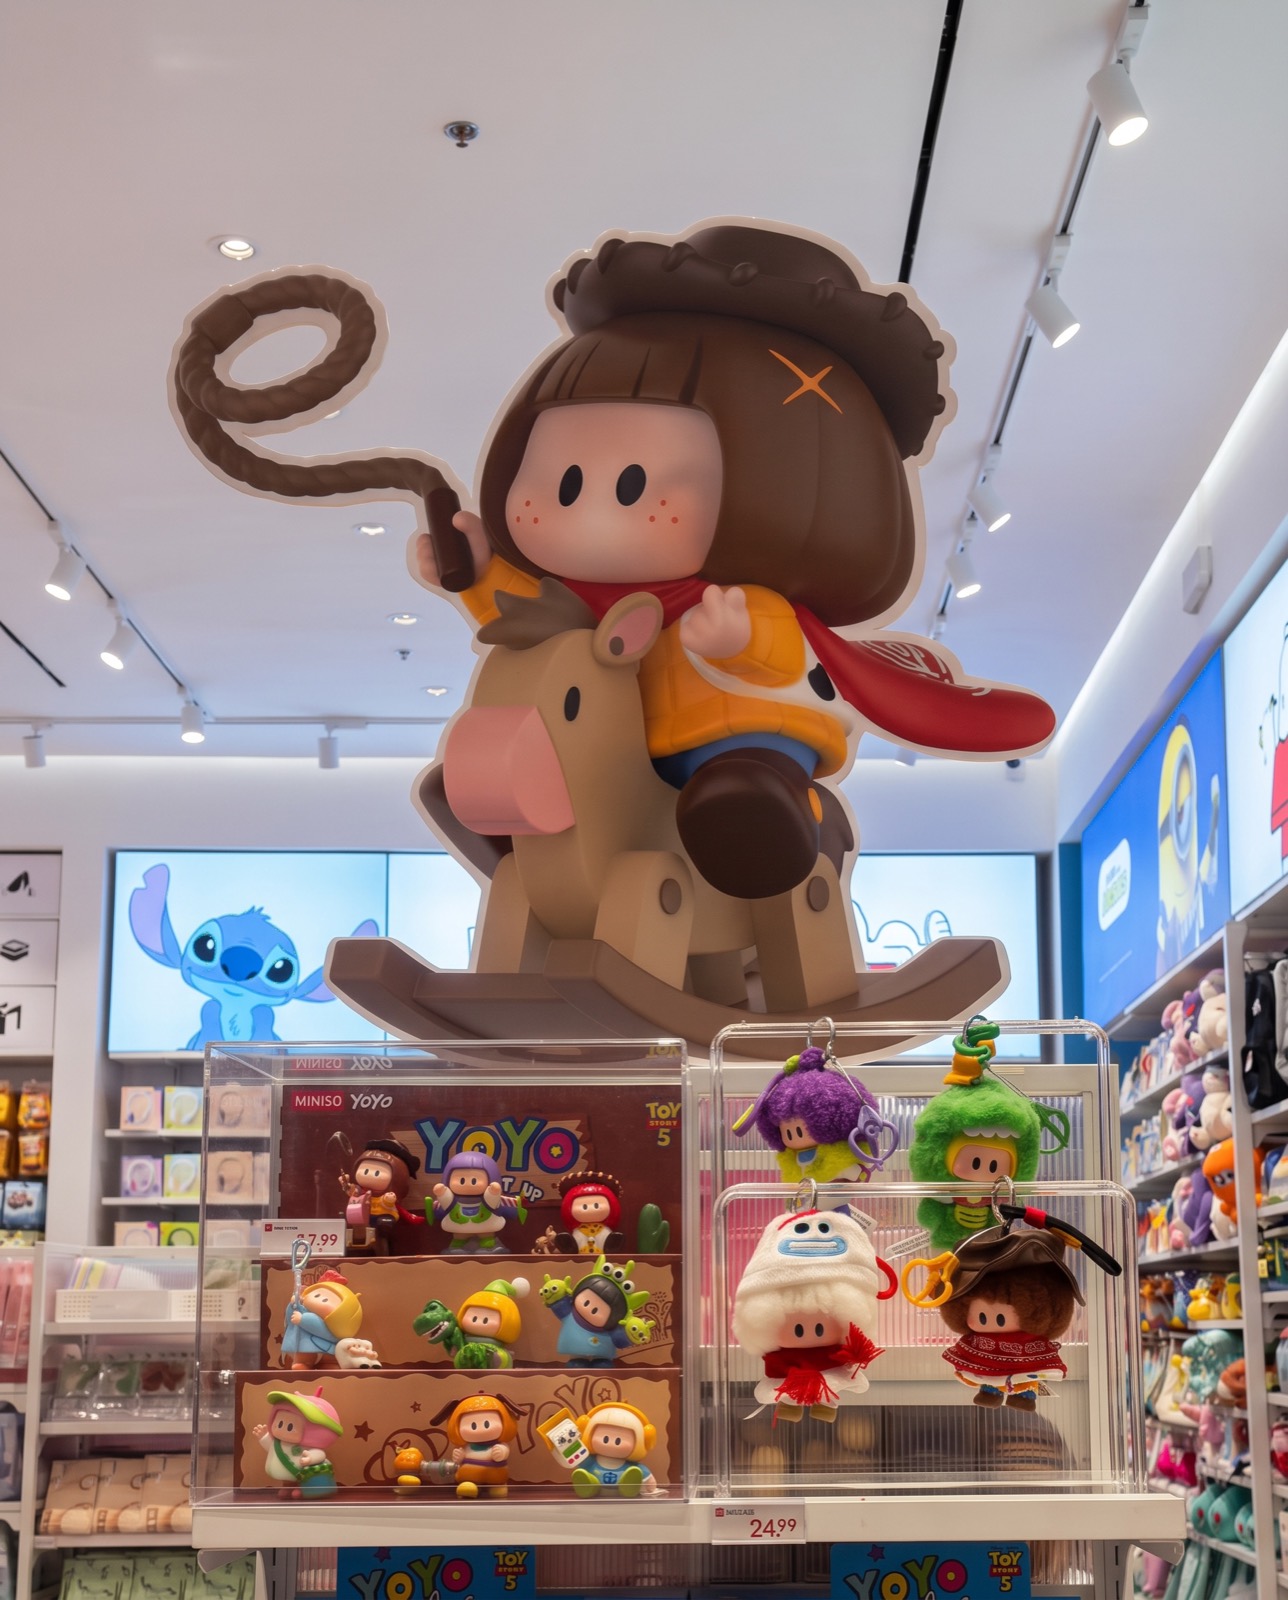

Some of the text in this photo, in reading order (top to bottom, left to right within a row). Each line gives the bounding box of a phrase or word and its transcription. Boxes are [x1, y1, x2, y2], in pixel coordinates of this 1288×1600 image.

[294, 1093, 393, 1110] MINISO YOYO
[645, 1101, 682, 1119] TOY
[415, 1116, 580, 1174] YOYO
[656, 1127, 671, 1147] 5
[522, 1183, 544, 1202] UP
[749, 1518, 797, 1538] 24.99
[494, 1551, 528, 1566] TOY
[988, 1551, 1022, 1567] TOY
[504, 1574, 517, 1590] 5
[1000, 1575, 1012, 1592] 5
